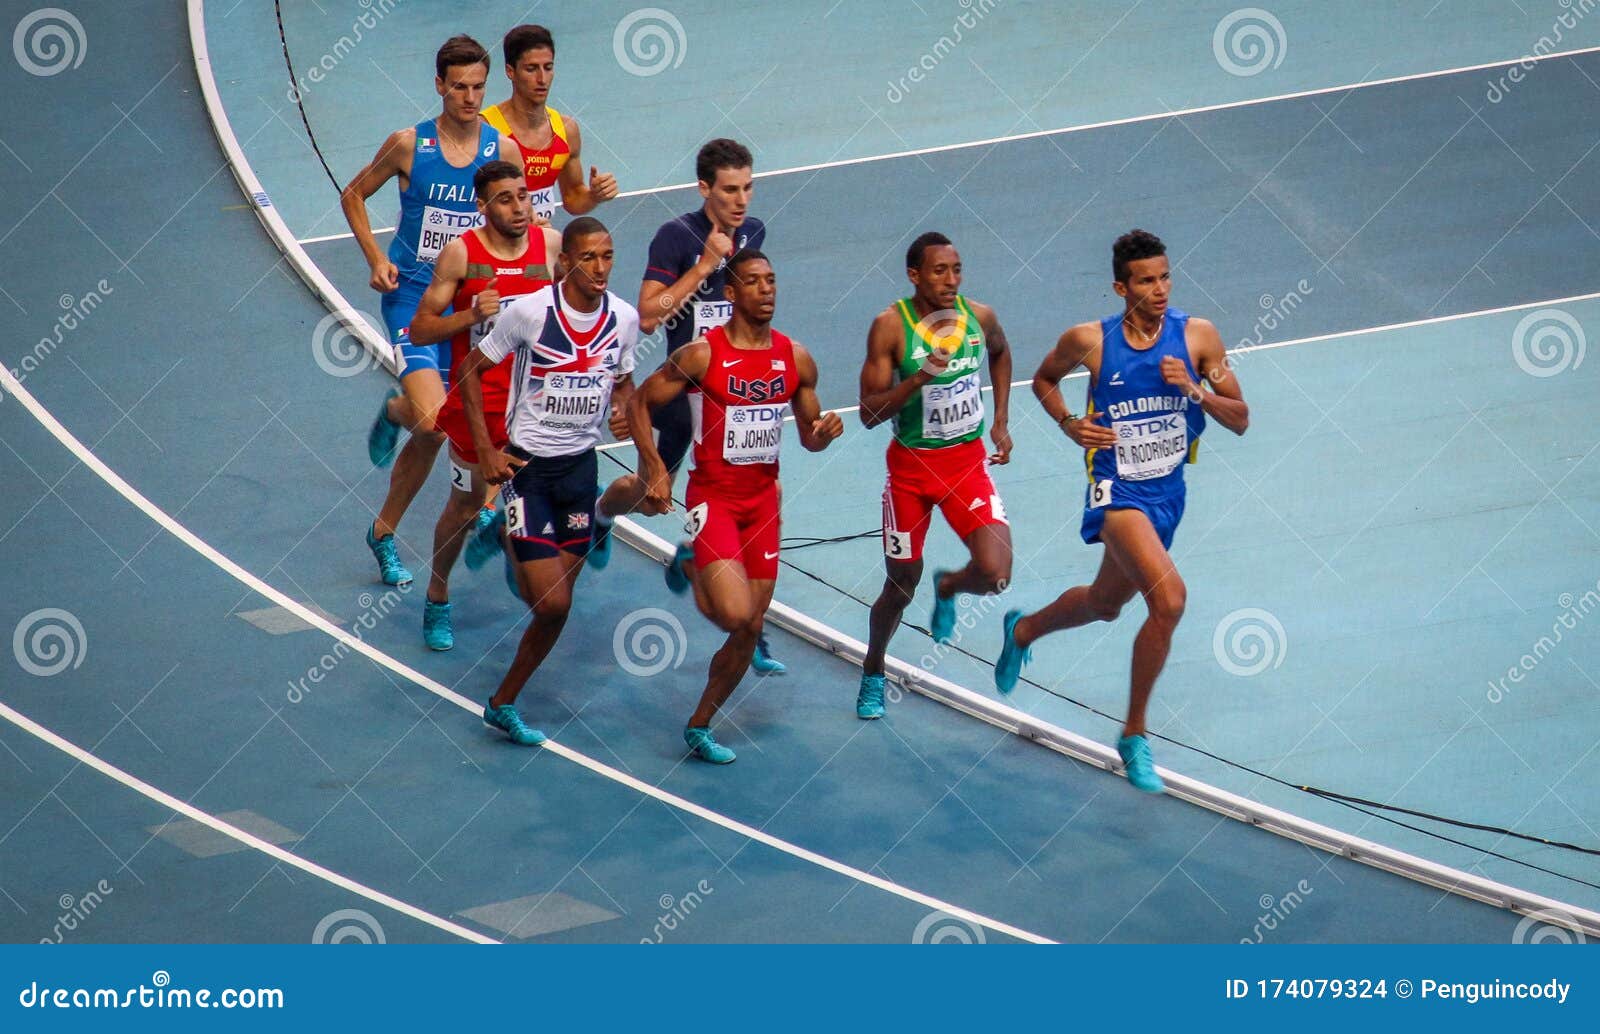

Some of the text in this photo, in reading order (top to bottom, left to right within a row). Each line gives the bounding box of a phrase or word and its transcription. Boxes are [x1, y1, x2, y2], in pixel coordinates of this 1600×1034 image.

[527, 166, 548, 176] ESP
[428, 183, 477, 203] ITALI
[530, 191, 550, 206] DK
[443, 212, 483, 228] TDK
[564, 374, 605, 389] TDK
[727, 374, 787, 403] USA
[943, 377, 976, 399] TDK
[745, 407, 785, 422] TDK
[928, 393, 980, 425] AMAN
[1107, 396, 1189, 420] COLOMBIA
[1132, 416, 1179, 437] TDK
[726, 430, 738, 449] B.
[452, 467, 464, 487] 2
[1094, 481, 1105, 501] 6
[508, 507, 517, 528] 8
[692, 510, 701, 532] 5
[890, 534, 903, 556] 3
